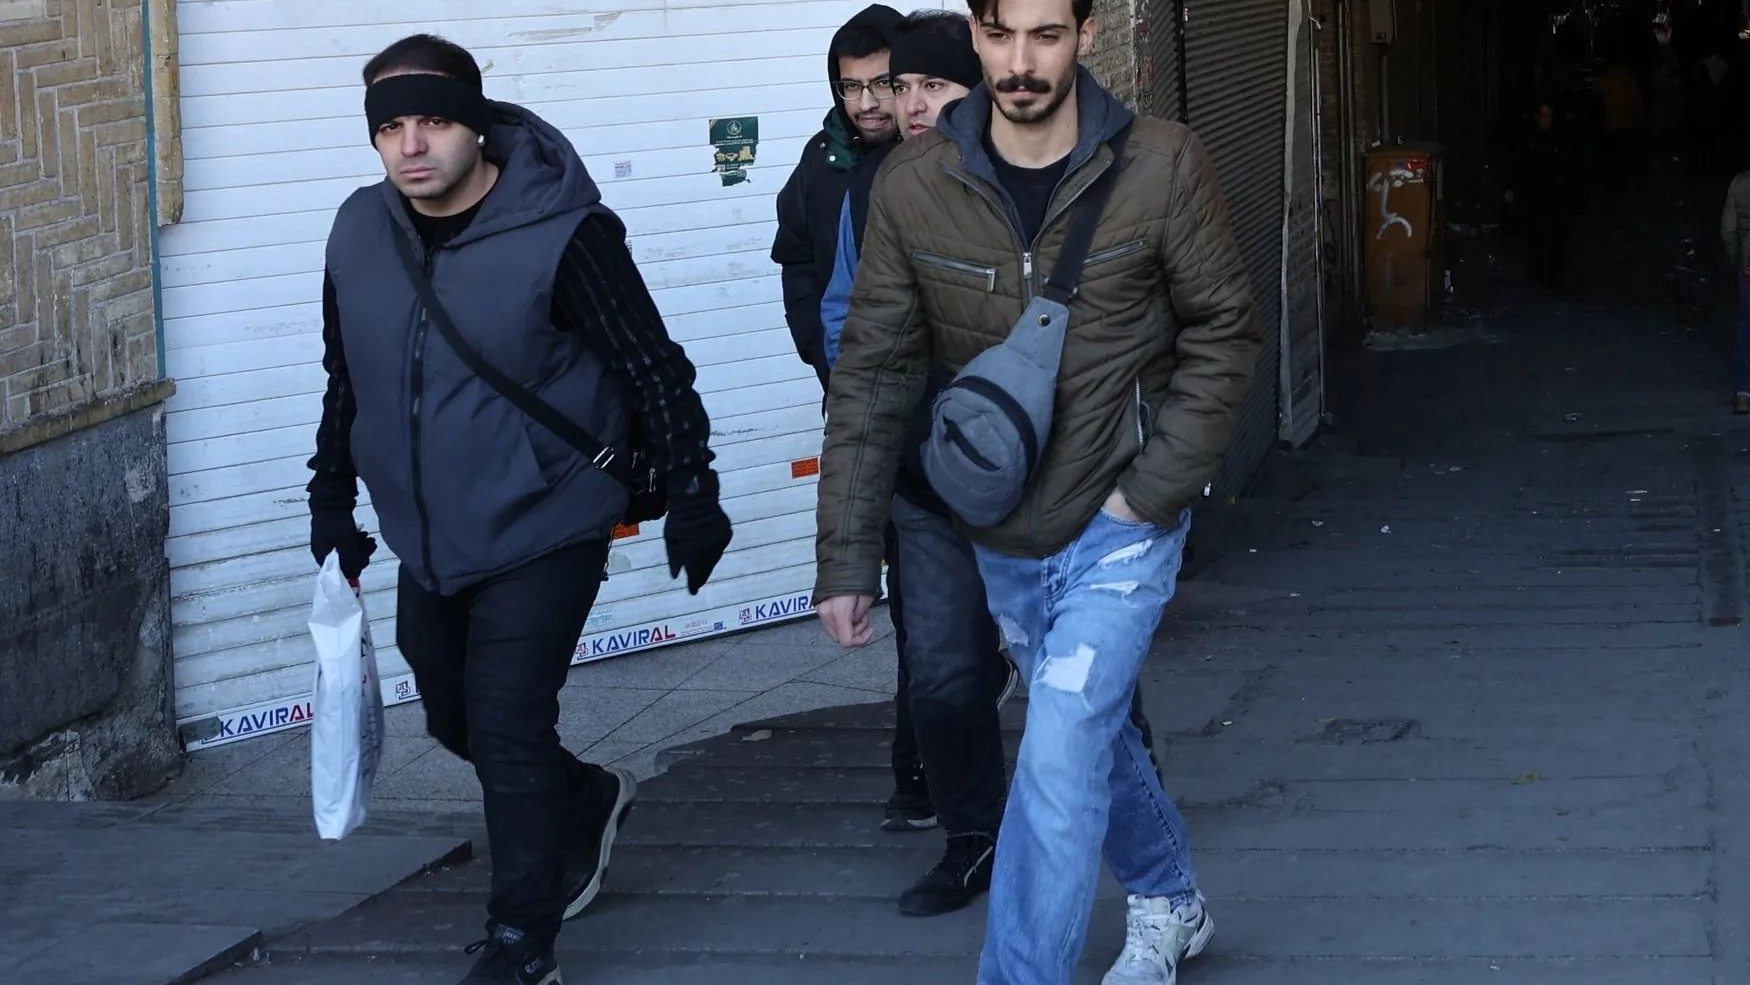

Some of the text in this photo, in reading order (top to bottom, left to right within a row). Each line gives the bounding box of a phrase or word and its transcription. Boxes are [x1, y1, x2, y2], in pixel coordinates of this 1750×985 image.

[755, 595, 816, 620] KAVIR
[592, 625, 676, 655] KAVIRAL
[220, 702, 314, 737] KAVIRAL
